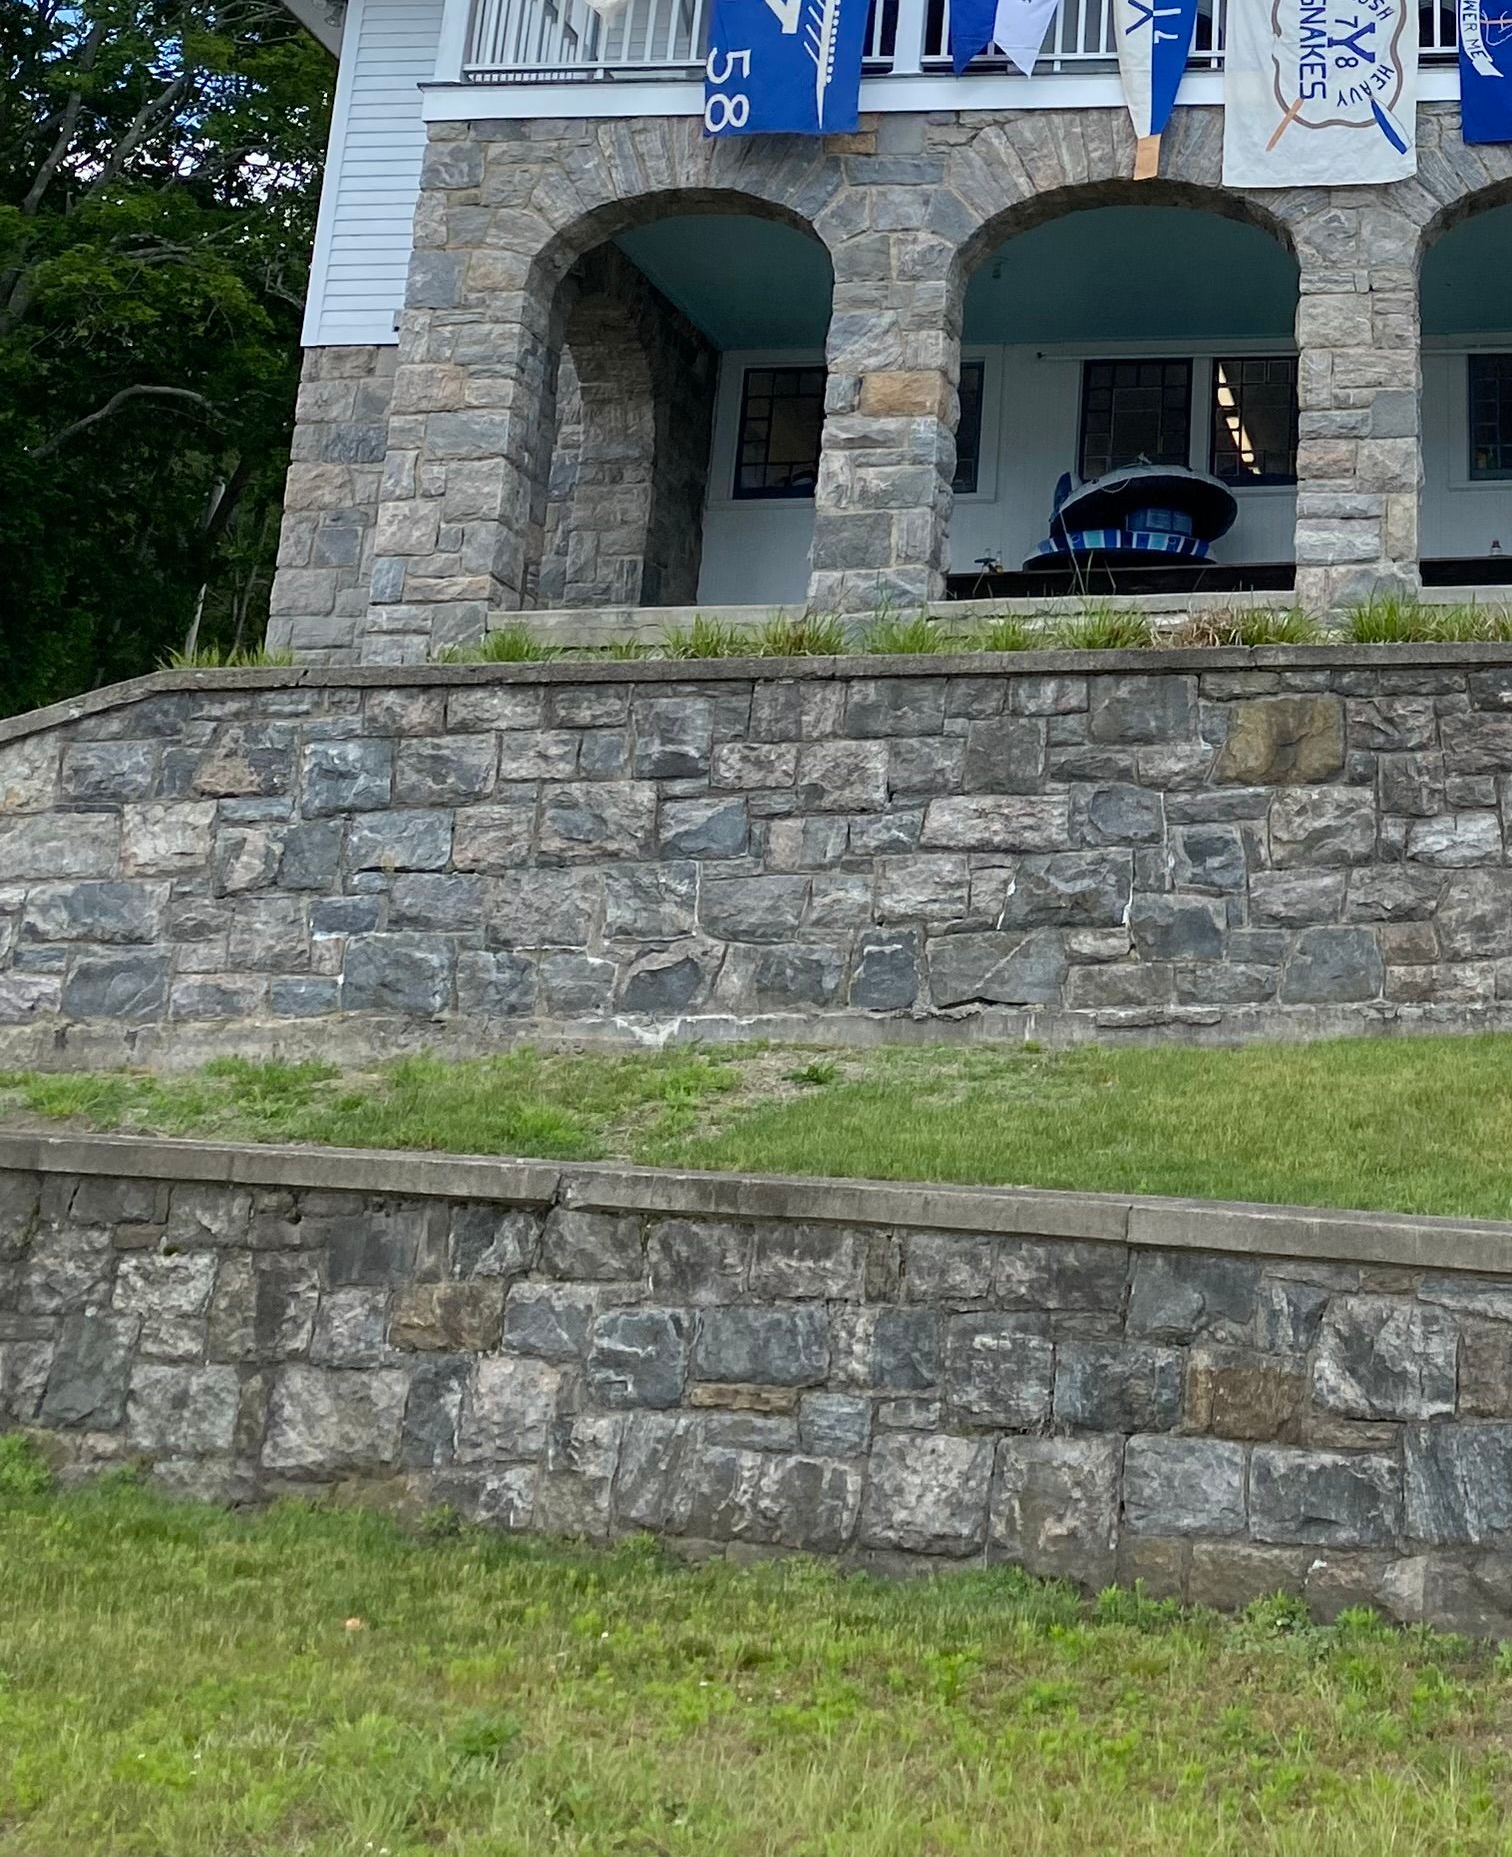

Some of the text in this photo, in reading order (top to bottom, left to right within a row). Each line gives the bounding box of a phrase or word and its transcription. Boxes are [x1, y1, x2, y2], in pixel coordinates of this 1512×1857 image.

[1466, 38, 1488, 59] ME
[705, 47, 751, 133] 58
[1336, 64, 1395, 107] HEAVY
